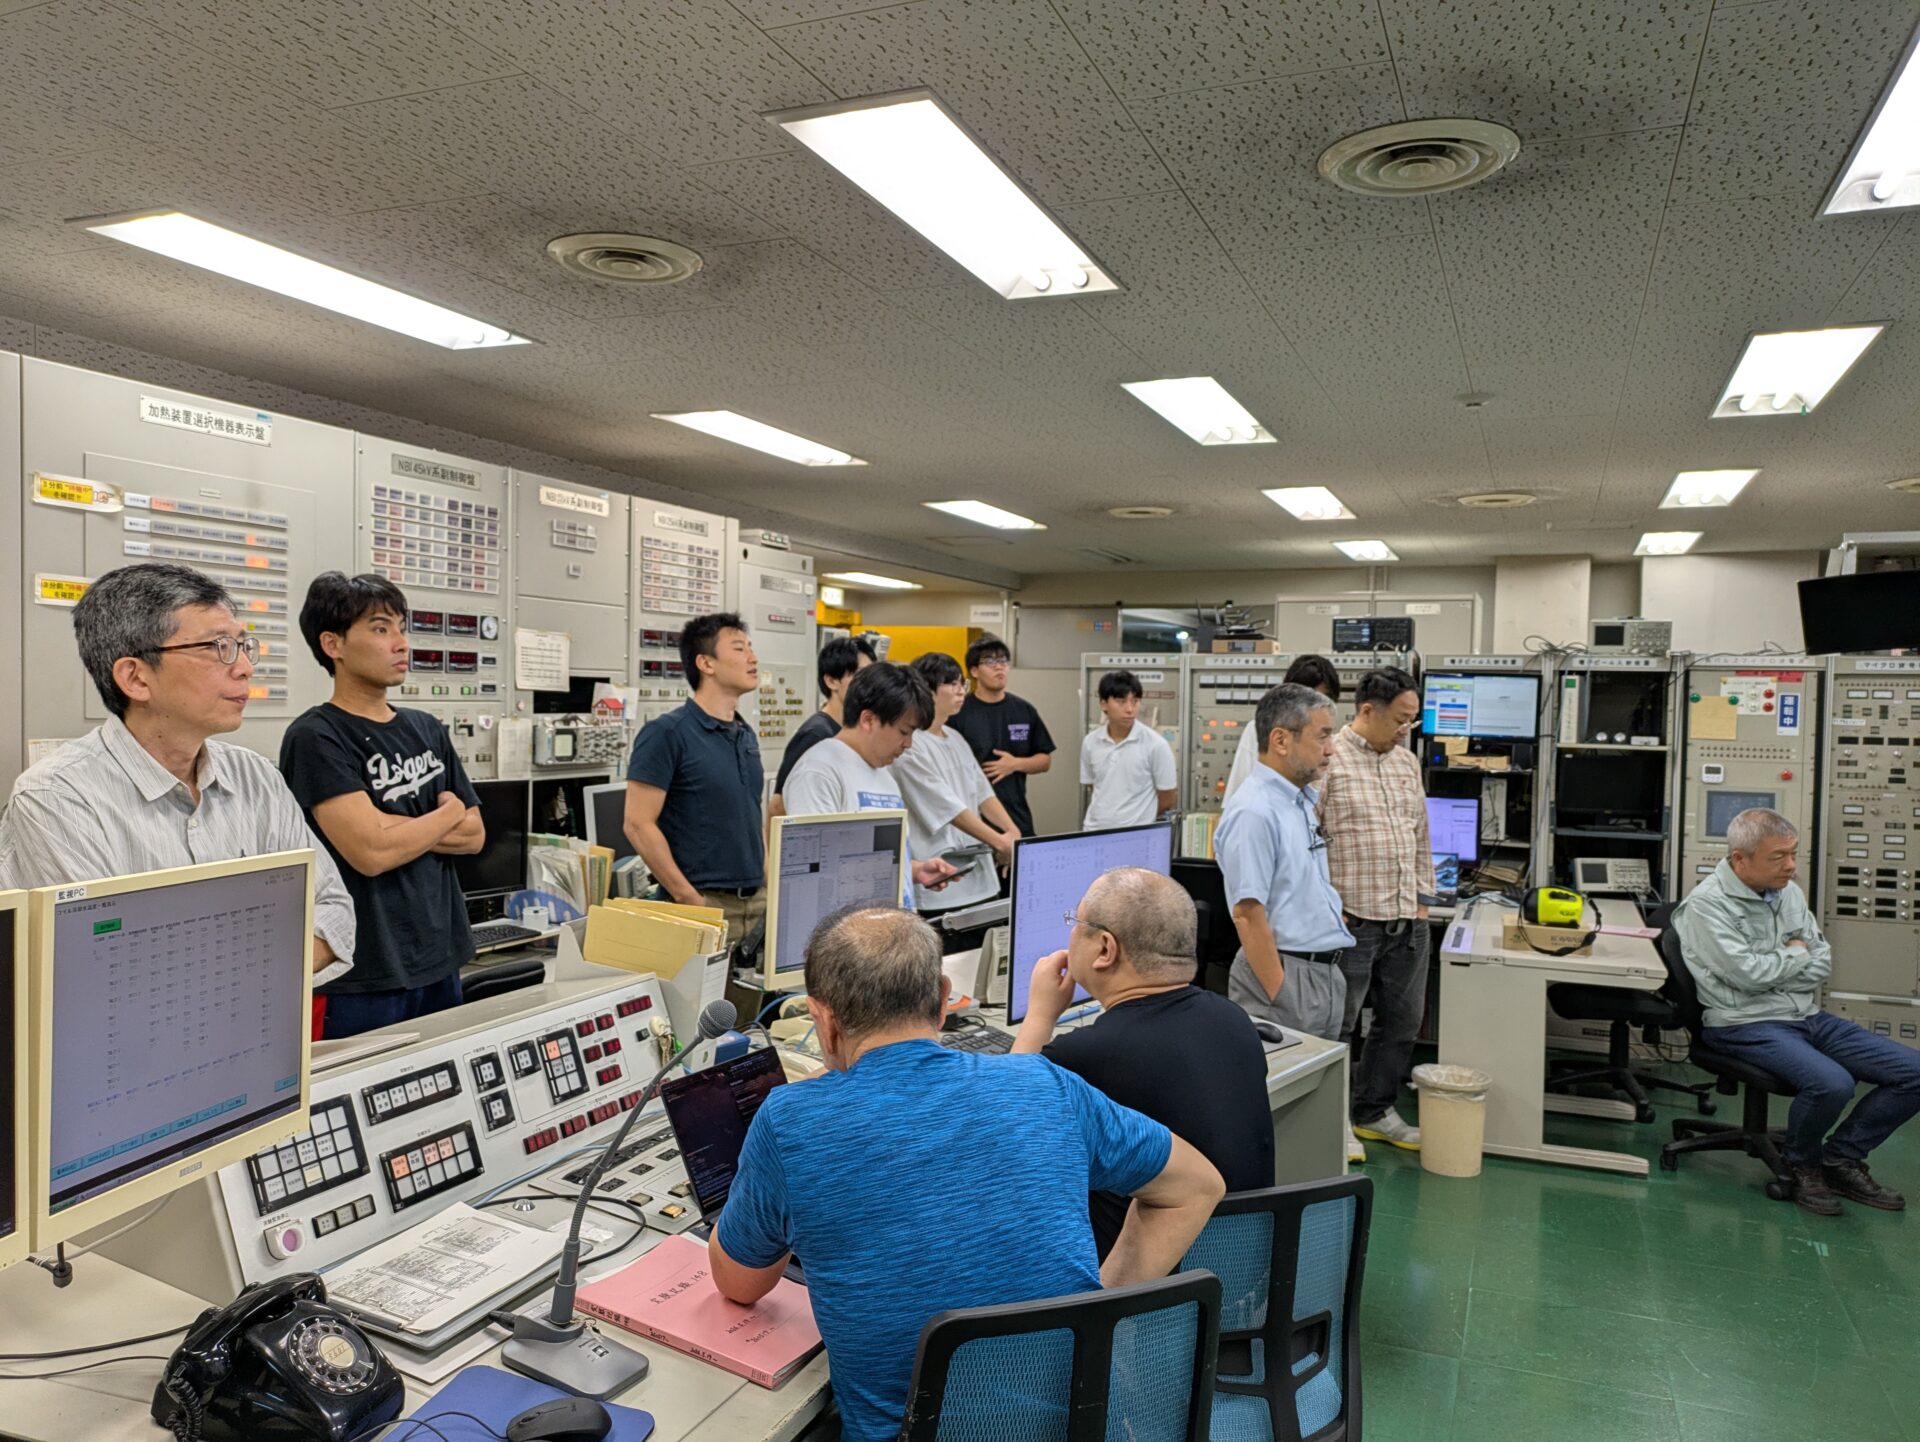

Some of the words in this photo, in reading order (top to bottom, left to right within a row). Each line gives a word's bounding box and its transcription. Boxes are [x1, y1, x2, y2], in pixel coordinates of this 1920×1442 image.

[148, 403, 265, 440] 加熱装置選択機器表示盤
[1783, 696, 1796, 726] 運転中
